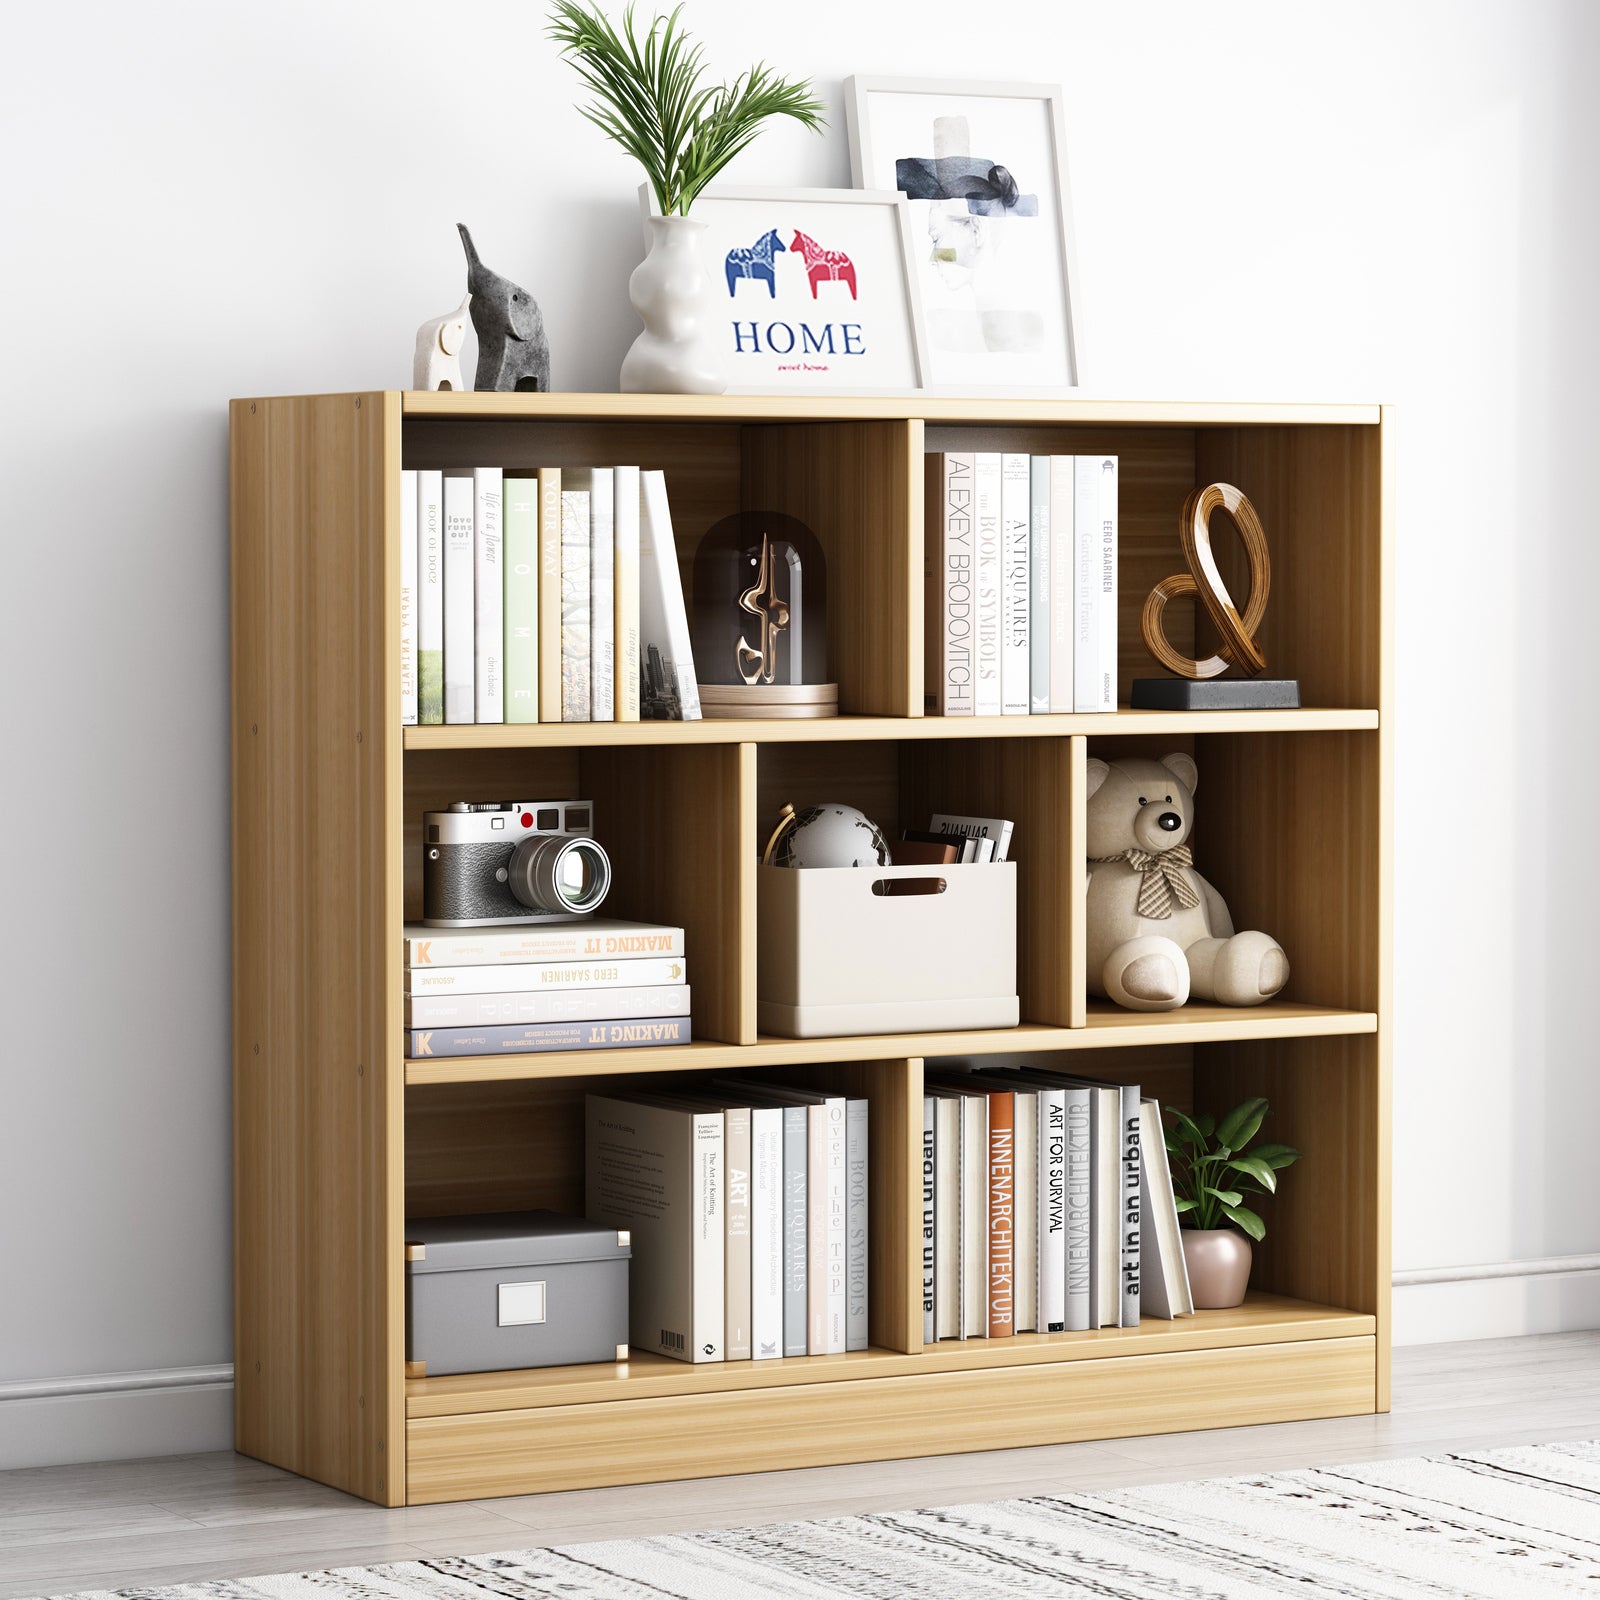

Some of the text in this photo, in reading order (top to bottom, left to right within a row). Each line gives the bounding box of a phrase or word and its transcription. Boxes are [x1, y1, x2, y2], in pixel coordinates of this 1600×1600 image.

[731, 321, 866, 355] HOME
[803, 363, 829, 371] home
[448, 514, 472, 524] love
[480, 491, 500, 508] life
[485, 512, 497, 521] is
[479, 531, 500, 564] flower
[545, 480, 557, 577] YOUR WAY
[980, 516, 996, 567] BOOK
[1040, 505, 1048, 602] NEW URBAN HOUSING
[1079, 533, 1092, 584] Gardens
[1103, 520, 1112, 593] EERO SAARINEN
[514, 502, 531, 698] HOME
[948, 460, 970, 699] ALEXEY BRODOVITCH
[1010, 520, 1027, 648] ANTIQUAIRES
[979, 588, 997, 680] SYMBOLS
[1080, 602, 1092, 643] France
[487, 656, 498, 697] chris choice
[601, 641, 614, 710] love in prague
[625, 628, 639, 712] stronger than sin
[417, 941, 432, 964] K
[584, 935, 673, 954] MAKING IT
[421, 977, 455, 985] ASSOULINE
[541, 968, 618, 983] EERO SAARINEN
[417, 1032, 433, 1055] K
[535, 1037, 581, 1045] MANUFACTURING
[545, 1029, 570, 1037] PRODUCT
[589, 1023, 679, 1043] MAKING IT
[758, 1132, 767, 1189] Virginia McLeod
[769, 1131, 778, 1152] Detail
[709, 1179, 716, 1187] of
[730, 1168, 748, 1206] ART
[768, 1161, 778, 1212] Contemporary
[850, 1160, 865, 1209] BOOK
[1050, 1104, 1063, 1233] ART FOR SURVIVAL
[708, 1188, 716, 1215] Knitting
[1069, 1103, 1089, 1296] INNENARCHITEKTUR
[1122, 1117, 1139, 1295] art in an urban
[770, 1213, 778, 1252] Residential
[791, 1170, 806, 1292] ANTIQUAIRES
[813, 1204, 824, 1270] BORDEAUX
[924, 1209, 933, 1239] an
[991, 1128, 1012, 1325] INNENARCHITEKTUR
[770, 1254, 778, 1296] Architecture
[850, 1229, 865, 1316] SYMBOLS
